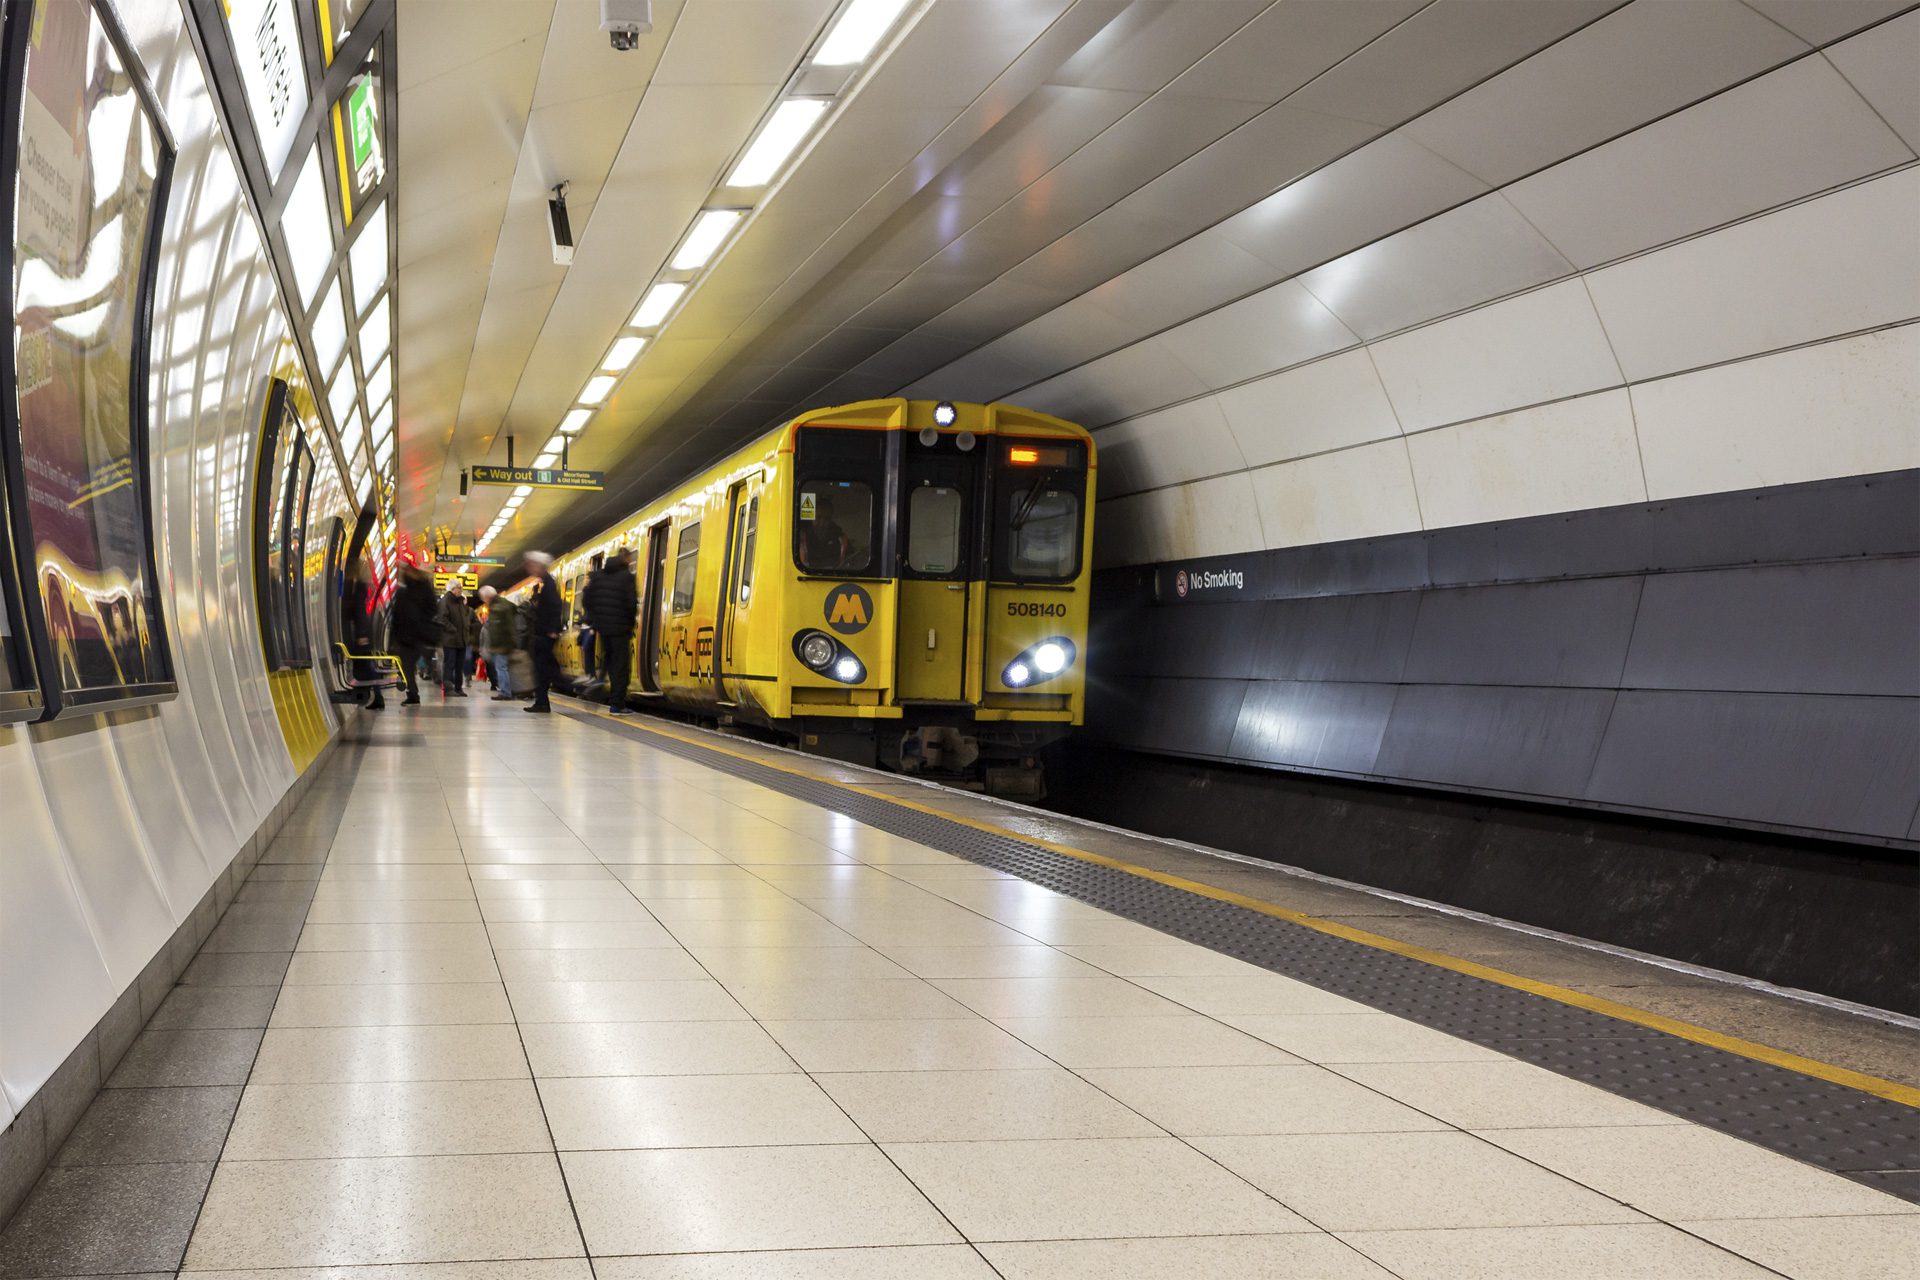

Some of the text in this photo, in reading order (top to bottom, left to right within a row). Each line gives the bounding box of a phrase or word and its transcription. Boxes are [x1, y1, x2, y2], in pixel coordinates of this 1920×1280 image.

[254, 0, 292, 128] Moorfields
[27, 135, 55, 187] Cheaper
[490, 469, 532, 481] Way out
[1190, 569, 1244, 589] No Smoking
[829, 593, 868, 624] M
[1008, 602, 1067, 618] 508140
